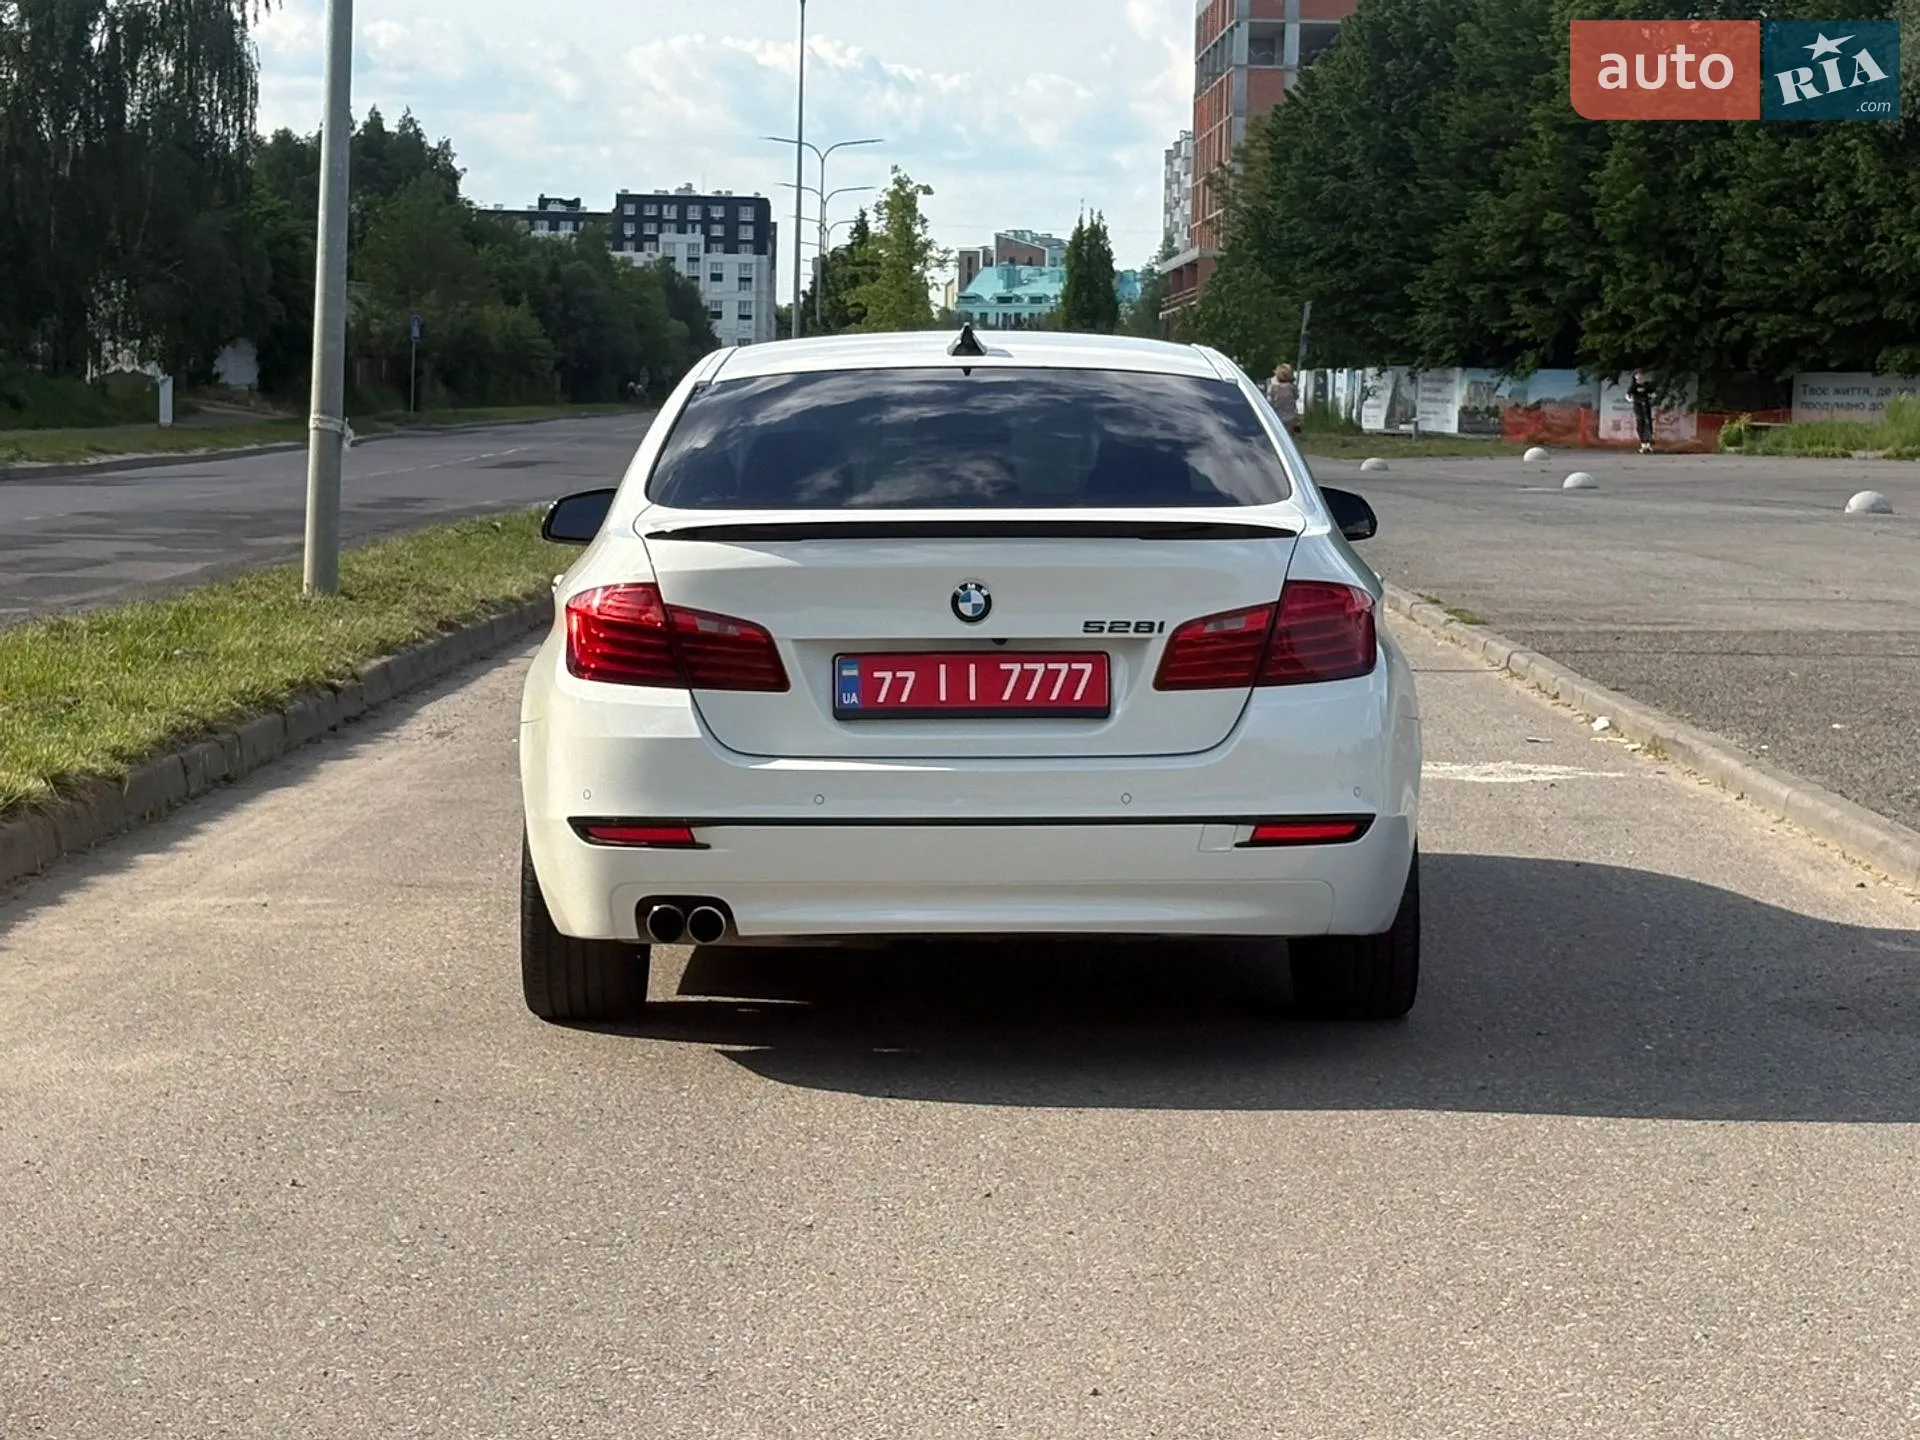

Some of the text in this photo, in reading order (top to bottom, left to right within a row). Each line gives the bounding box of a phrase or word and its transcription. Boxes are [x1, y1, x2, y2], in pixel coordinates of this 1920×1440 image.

[873, 670, 916, 703] 77
[999, 662, 1093, 701] 7777
[842, 692, 859, 705] UA
